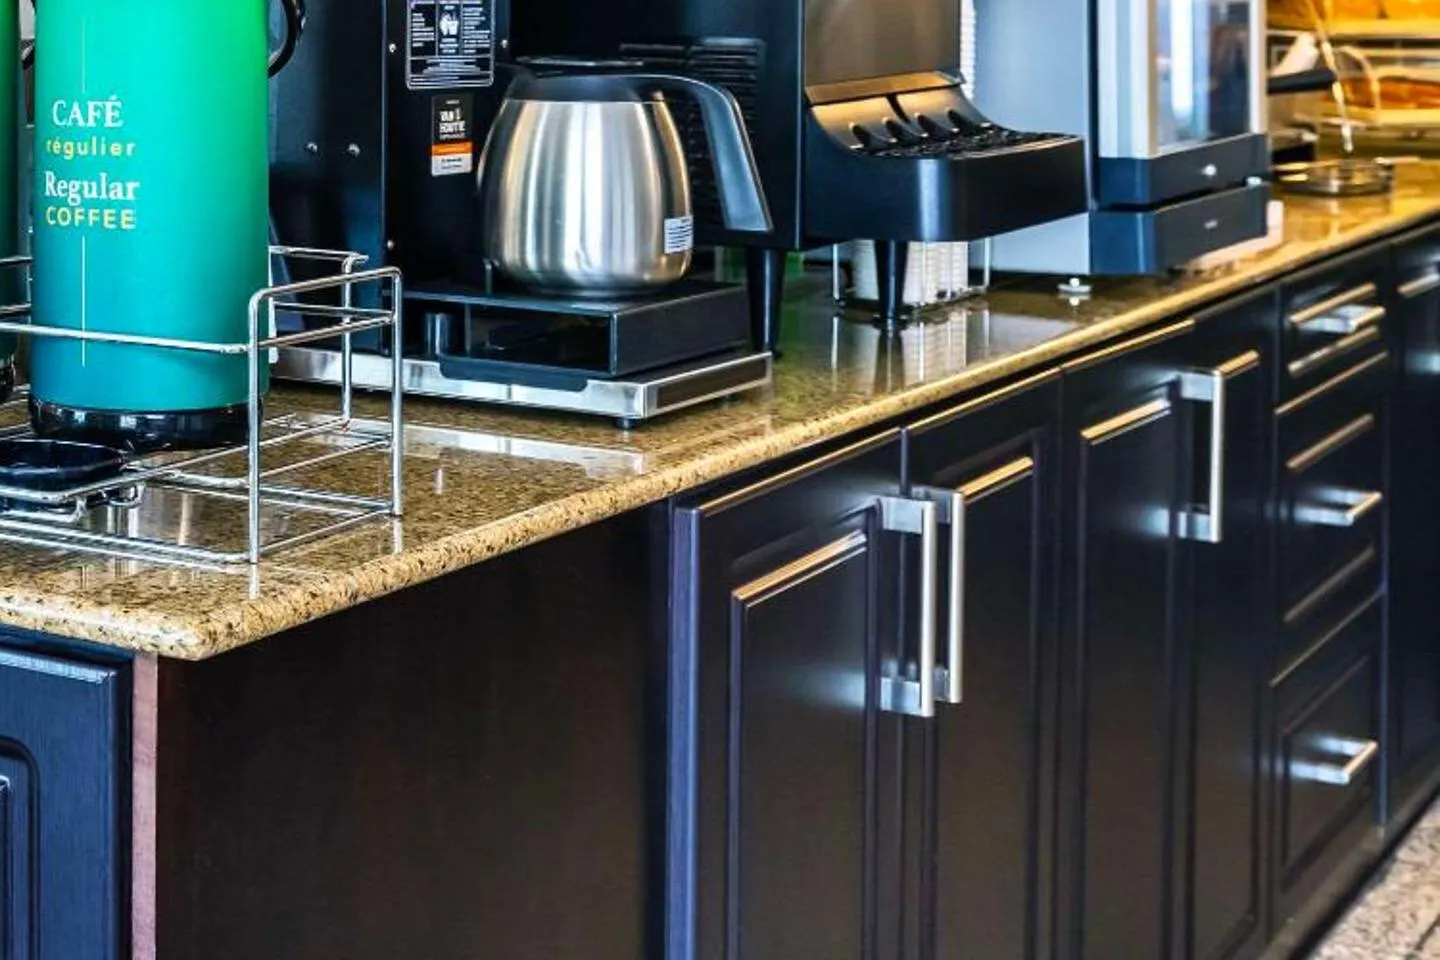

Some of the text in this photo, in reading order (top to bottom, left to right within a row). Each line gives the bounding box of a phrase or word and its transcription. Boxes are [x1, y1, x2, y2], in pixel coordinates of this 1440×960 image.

[52, 94, 124, 128] CAFÉ
[46, 135, 136, 160] régulier
[44, 170, 140, 206] Regular
[46, 206, 136, 229] COFFEE
